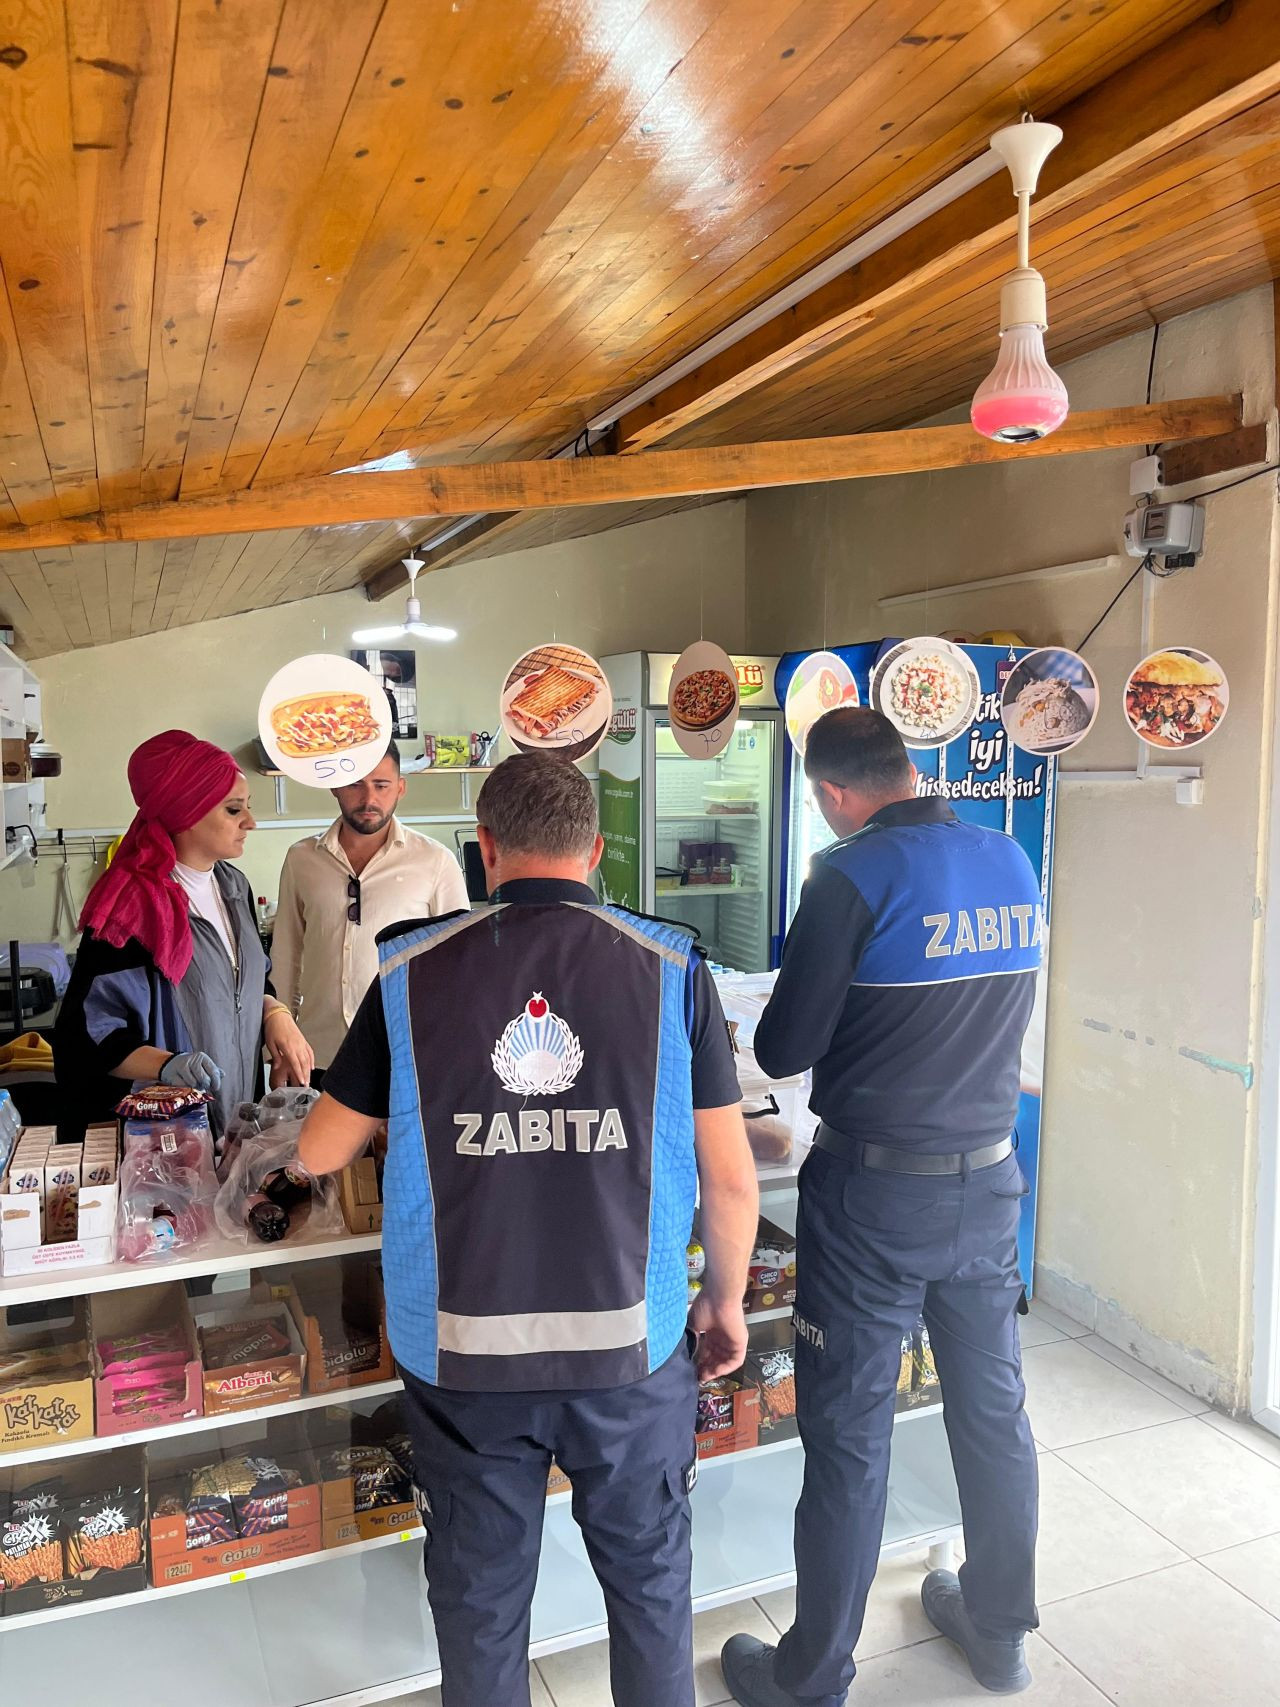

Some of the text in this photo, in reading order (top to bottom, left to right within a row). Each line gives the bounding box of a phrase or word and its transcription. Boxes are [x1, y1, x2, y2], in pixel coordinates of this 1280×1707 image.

[610, 708, 636, 736] güllü
[553, 728, 585, 747] 50
[698, 728, 722, 753] 70
[970, 729, 1004, 771] iyi
[314, 758, 356, 779] 50
[923, 904, 1042, 958] ZABITA
[136, 1101, 159, 1112] Gong
[453, 1108, 628, 1156] ZABITA
[216, 1371, 272, 1394] Albeni
[263, 1493, 288, 1508] Gong
[355, 1501, 373, 1510] ong
[3, 1519, 49, 1546] CRAX
[186, 1532, 211, 1550] Gong
[220, 1543, 263, 1566] Gong
